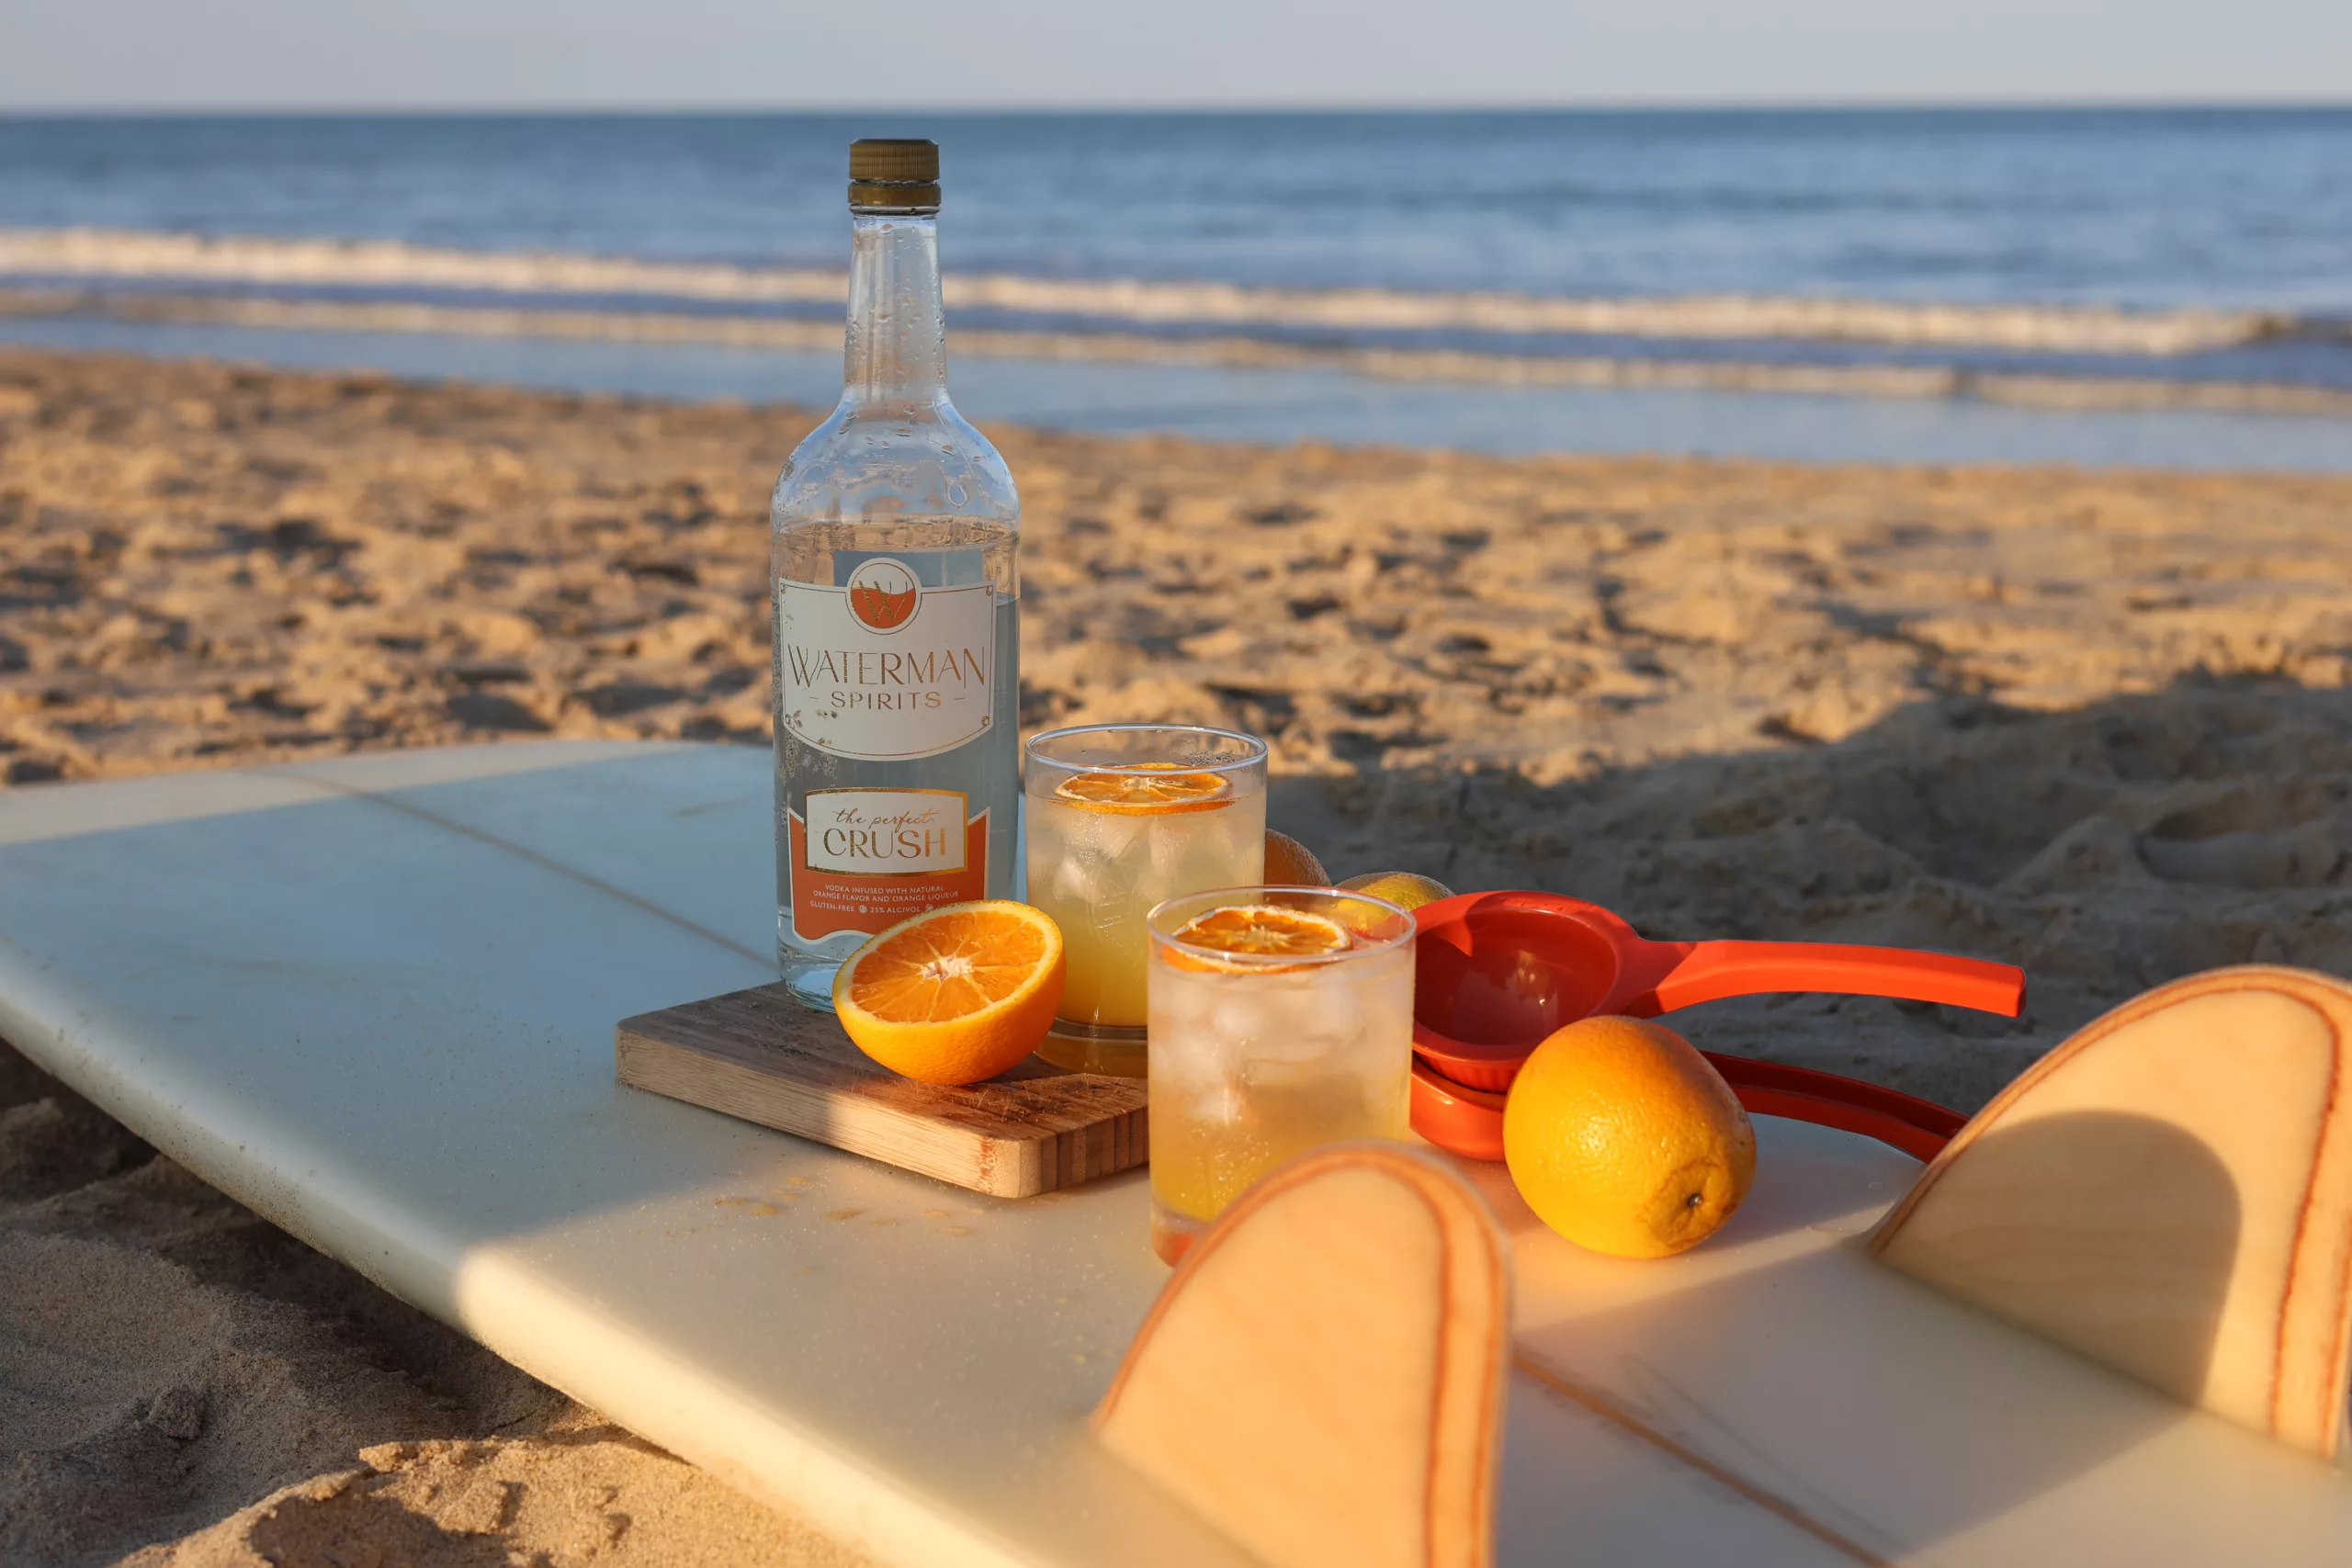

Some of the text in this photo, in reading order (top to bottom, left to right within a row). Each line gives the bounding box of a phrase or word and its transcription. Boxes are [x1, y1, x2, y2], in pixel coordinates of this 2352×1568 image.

[787, 644, 985, 689] WATERMAN
[831, 691, 942, 710] SPIRITS
[832, 807, 941, 834] the perfect
[823, 828, 946, 859] CRUSH
[812, 889, 841, 900] ORANGE
[842, 894, 871, 902] FLAVOR
[892, 894, 926, 902] ORANGE
[928, 890, 959, 900] LIQUEUR
[825, 884, 850, 893] VODKA
[852, 886, 884, 895] INFUSED
[910, 885, 944, 894] NATURAL
[809, 900, 854, 912] GLUTEN-FREE
[887, 906, 922, 914] ALC/VOL
